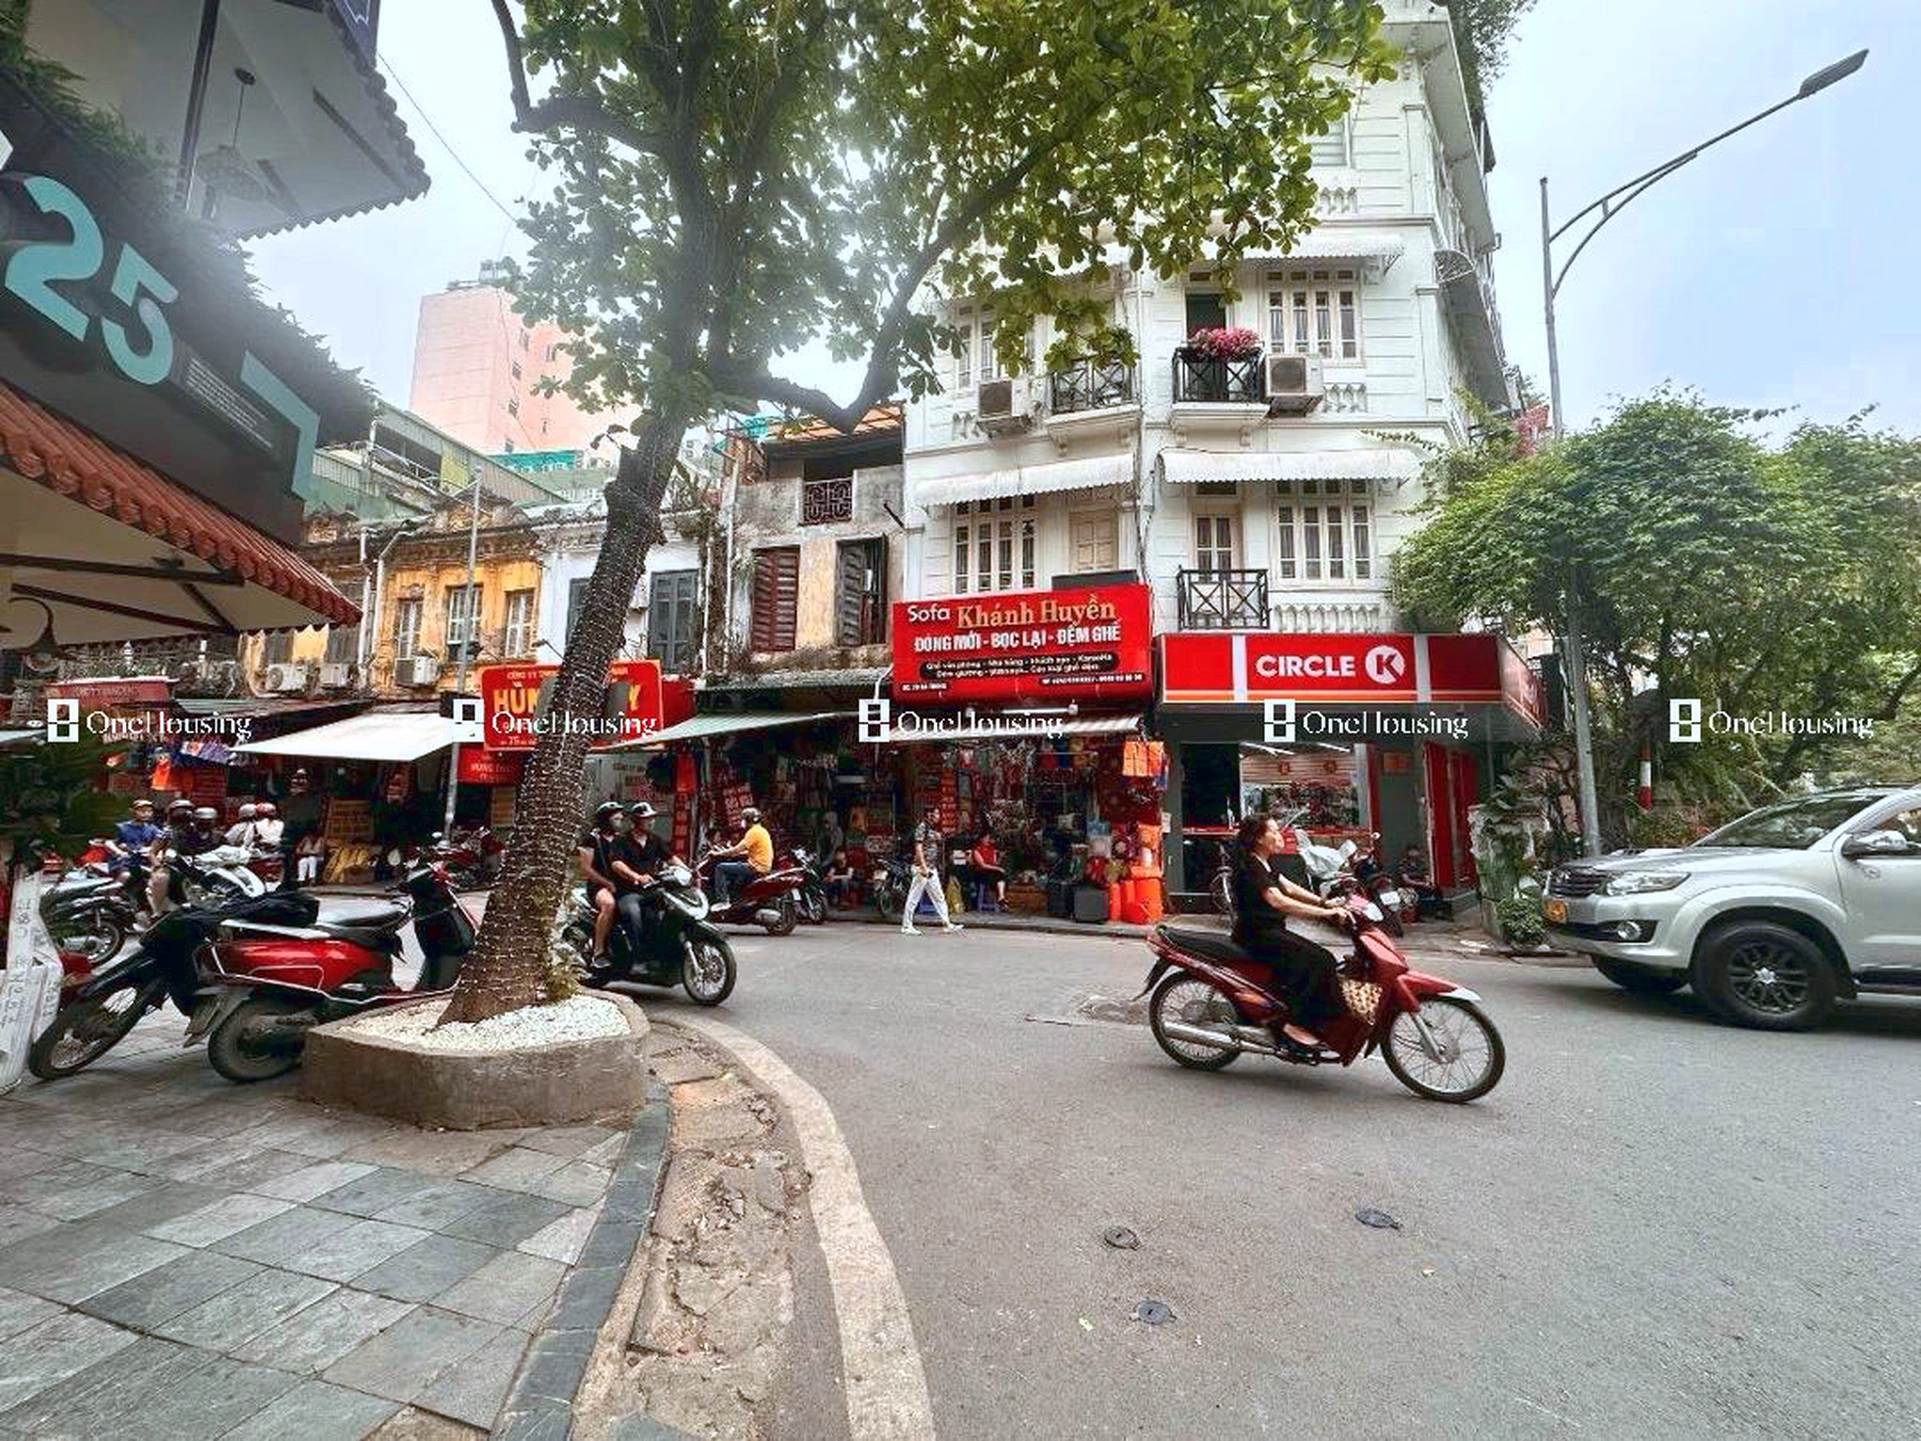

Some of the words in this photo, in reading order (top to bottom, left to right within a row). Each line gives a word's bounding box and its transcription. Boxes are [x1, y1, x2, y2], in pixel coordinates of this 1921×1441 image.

[907, 604, 950, 623] Sofa
[956, 600, 1035, 629] Khánh
[1039, 593, 1117, 625] Huyền
[1022, 628, 1046, 650] LẠI
[1256, 654, 1356, 678] CIRCLE
[1370, 648, 1405, 684] K
